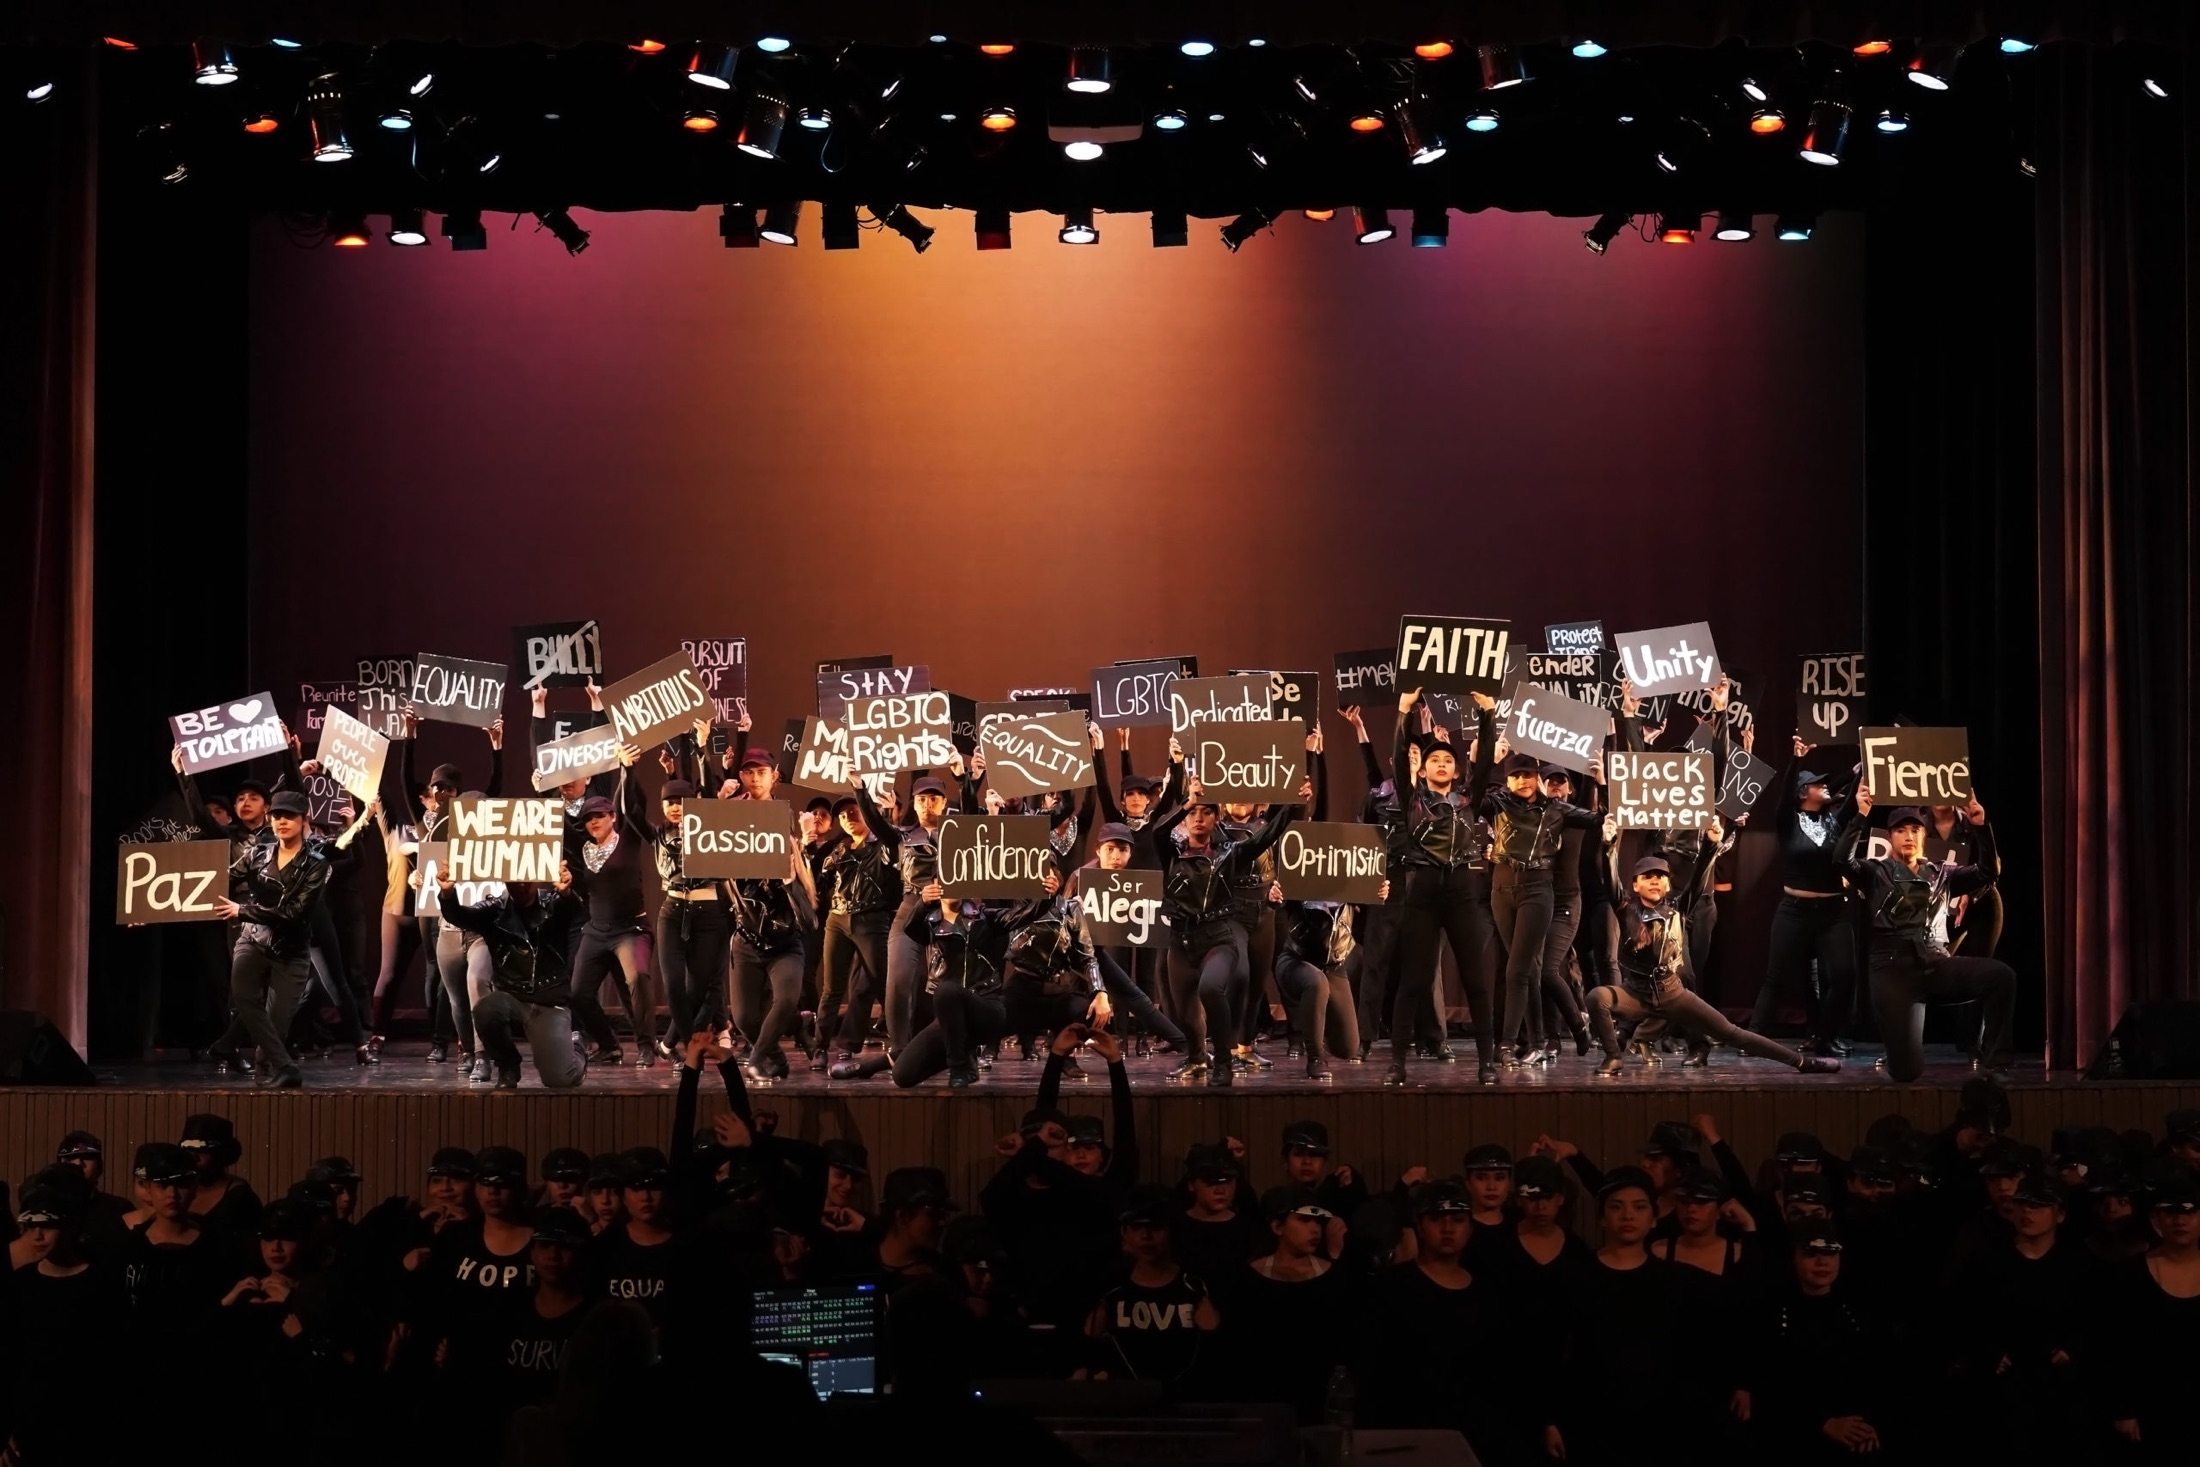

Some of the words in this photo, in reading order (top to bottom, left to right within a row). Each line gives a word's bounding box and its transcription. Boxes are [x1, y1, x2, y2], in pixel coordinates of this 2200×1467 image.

[1400, 625, 1508, 680] FAITH
[1622, 640, 1714, 687] Unity
[301, 684, 356, 703] Reunite
[412, 664, 505, 711] EQUALITY
[699, 666, 729, 691] OF
[1802, 655, 1866, 697] RISE
[359, 687, 409, 711] This
[610, 669, 704, 743] AMBITIOUS
[847, 692, 951, 731] LGBTQ
[1171, 685, 1272, 732] Dedicated
[175, 706, 224, 735] BE
[333, 712, 377, 753] PEOPLE
[1514, 699, 1593, 758] fuerza
[332, 739, 369, 774] over
[537, 738, 617, 775] DIVERSE
[852, 728, 951, 770] Rights
[980, 724, 1091, 782] EQUALITY
[1200, 741, 1295, 789] Beauty
[1611, 754, 1704, 783] Black
[1864, 736, 1969, 798] Fierce
[1621, 780, 1705, 806] Lives
[453, 800, 508, 837] WE
[509, 800, 564, 836] ARE
[683, 814, 785, 855] Passion
[1616, 806, 1709, 828] Matter
[448, 838, 561, 881] HUMAN
[938, 819, 1049, 885] Confidence
[1281, 830, 1385, 877] Optimistic
[125, 852, 217, 914] Paz
[1108, 873, 1143, 892] Ser
[1116, 1300, 1195, 1332] LOVE
